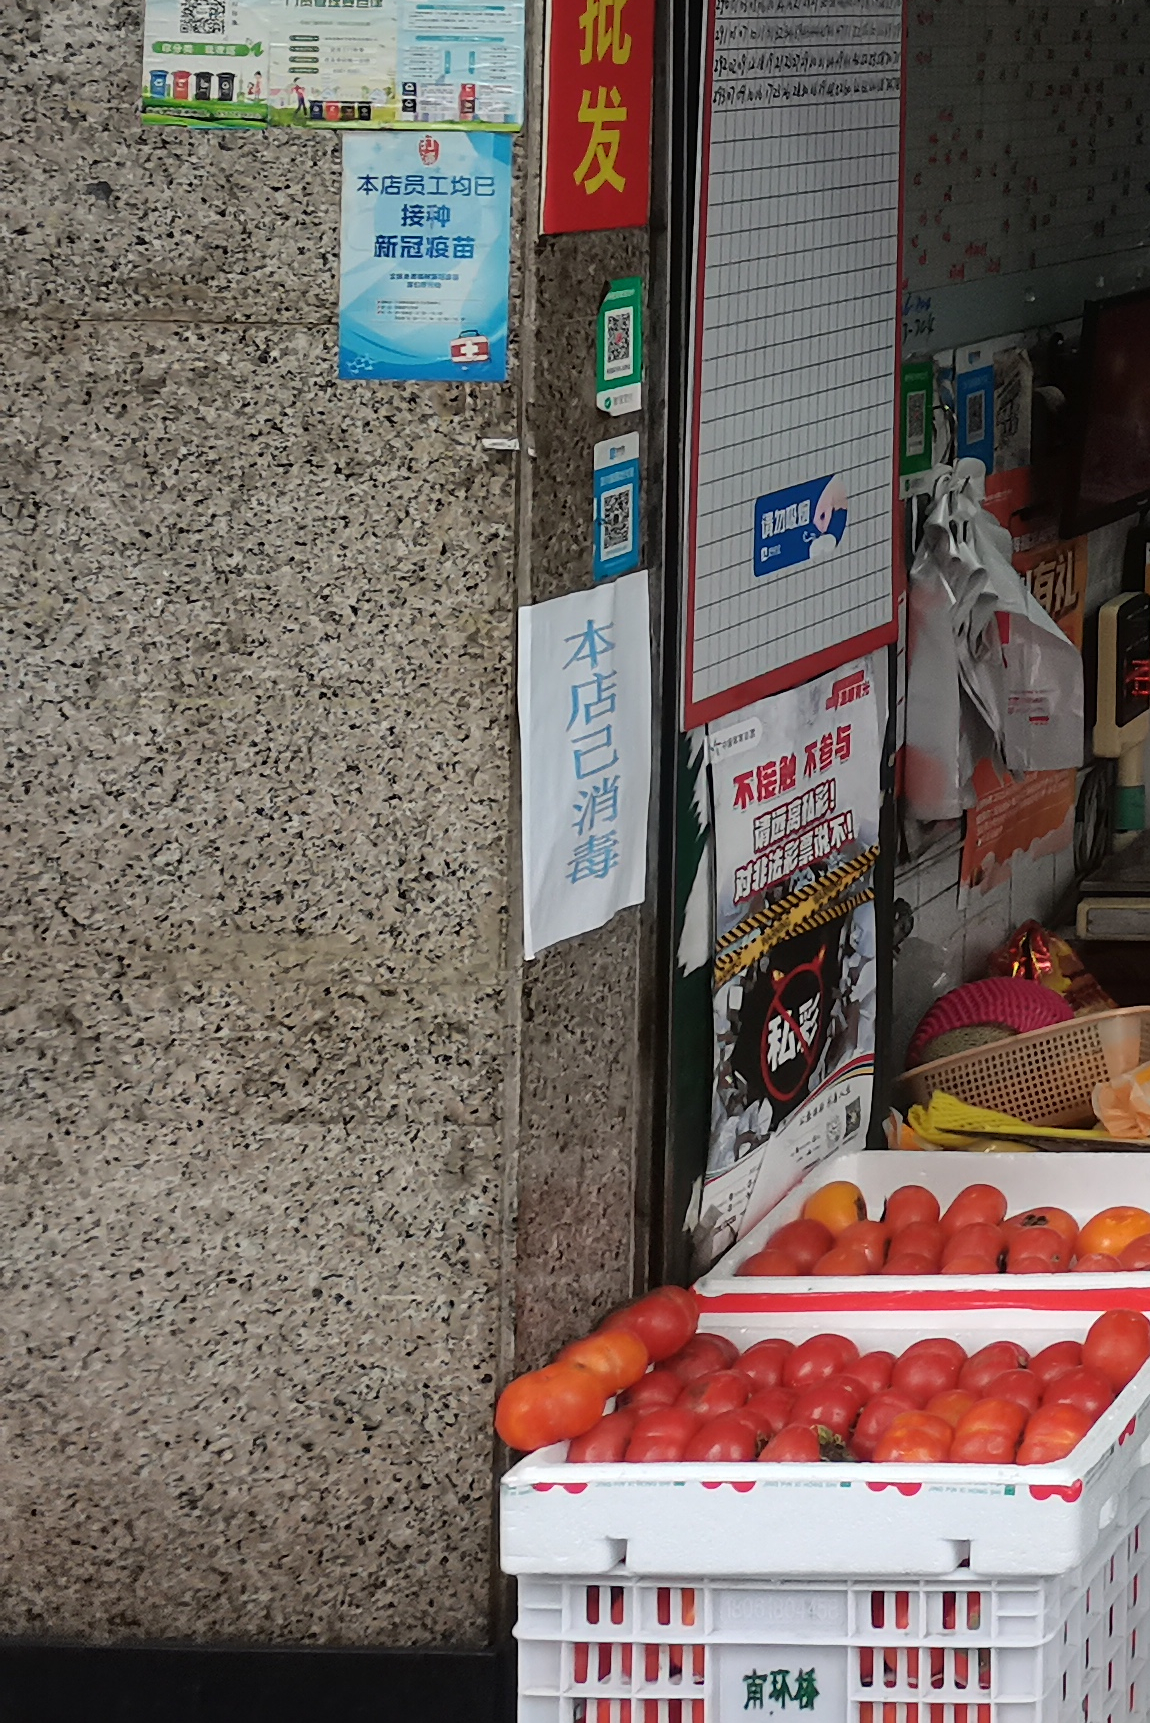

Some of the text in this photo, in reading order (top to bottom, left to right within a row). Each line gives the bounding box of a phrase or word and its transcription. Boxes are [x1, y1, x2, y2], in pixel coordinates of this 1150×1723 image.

[357, 174, 496, 197] 本店员工均已
[401, 204, 451, 229] 接种
[374, 234, 475, 259] 新冠疫苗
[762, 499, 810, 539] 请勿吸烟
[733, 724, 852, 809] 不接触 不参与
[767, 992, 821, 1072] 私彩
[743, 1667, 820, 1711] 南环桥
